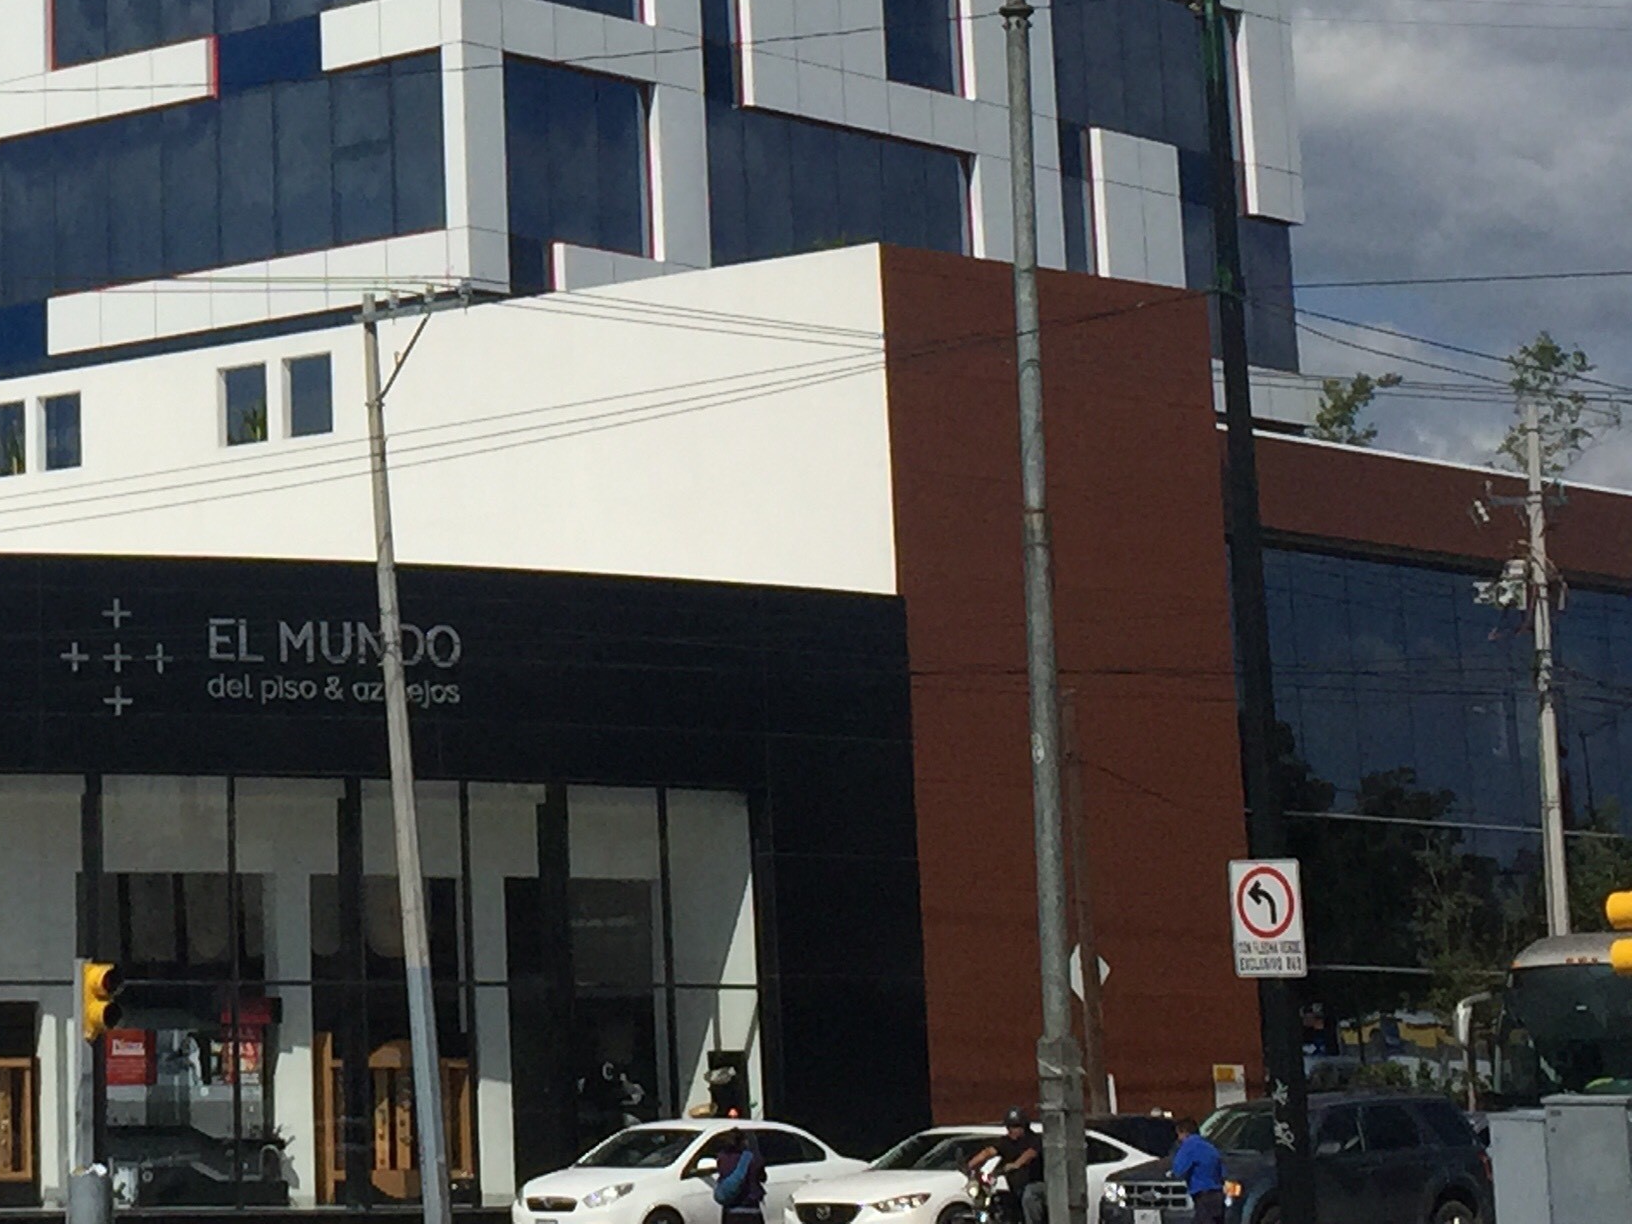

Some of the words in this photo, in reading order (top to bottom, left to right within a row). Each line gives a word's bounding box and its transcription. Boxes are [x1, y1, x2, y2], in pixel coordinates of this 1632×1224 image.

[208, 618, 265, 663] EL
[278, 620, 462, 668] MUNDO
[207, 674, 254, 700] del
[324, 676, 345, 701] &
[353, 680, 461, 709] azejos
